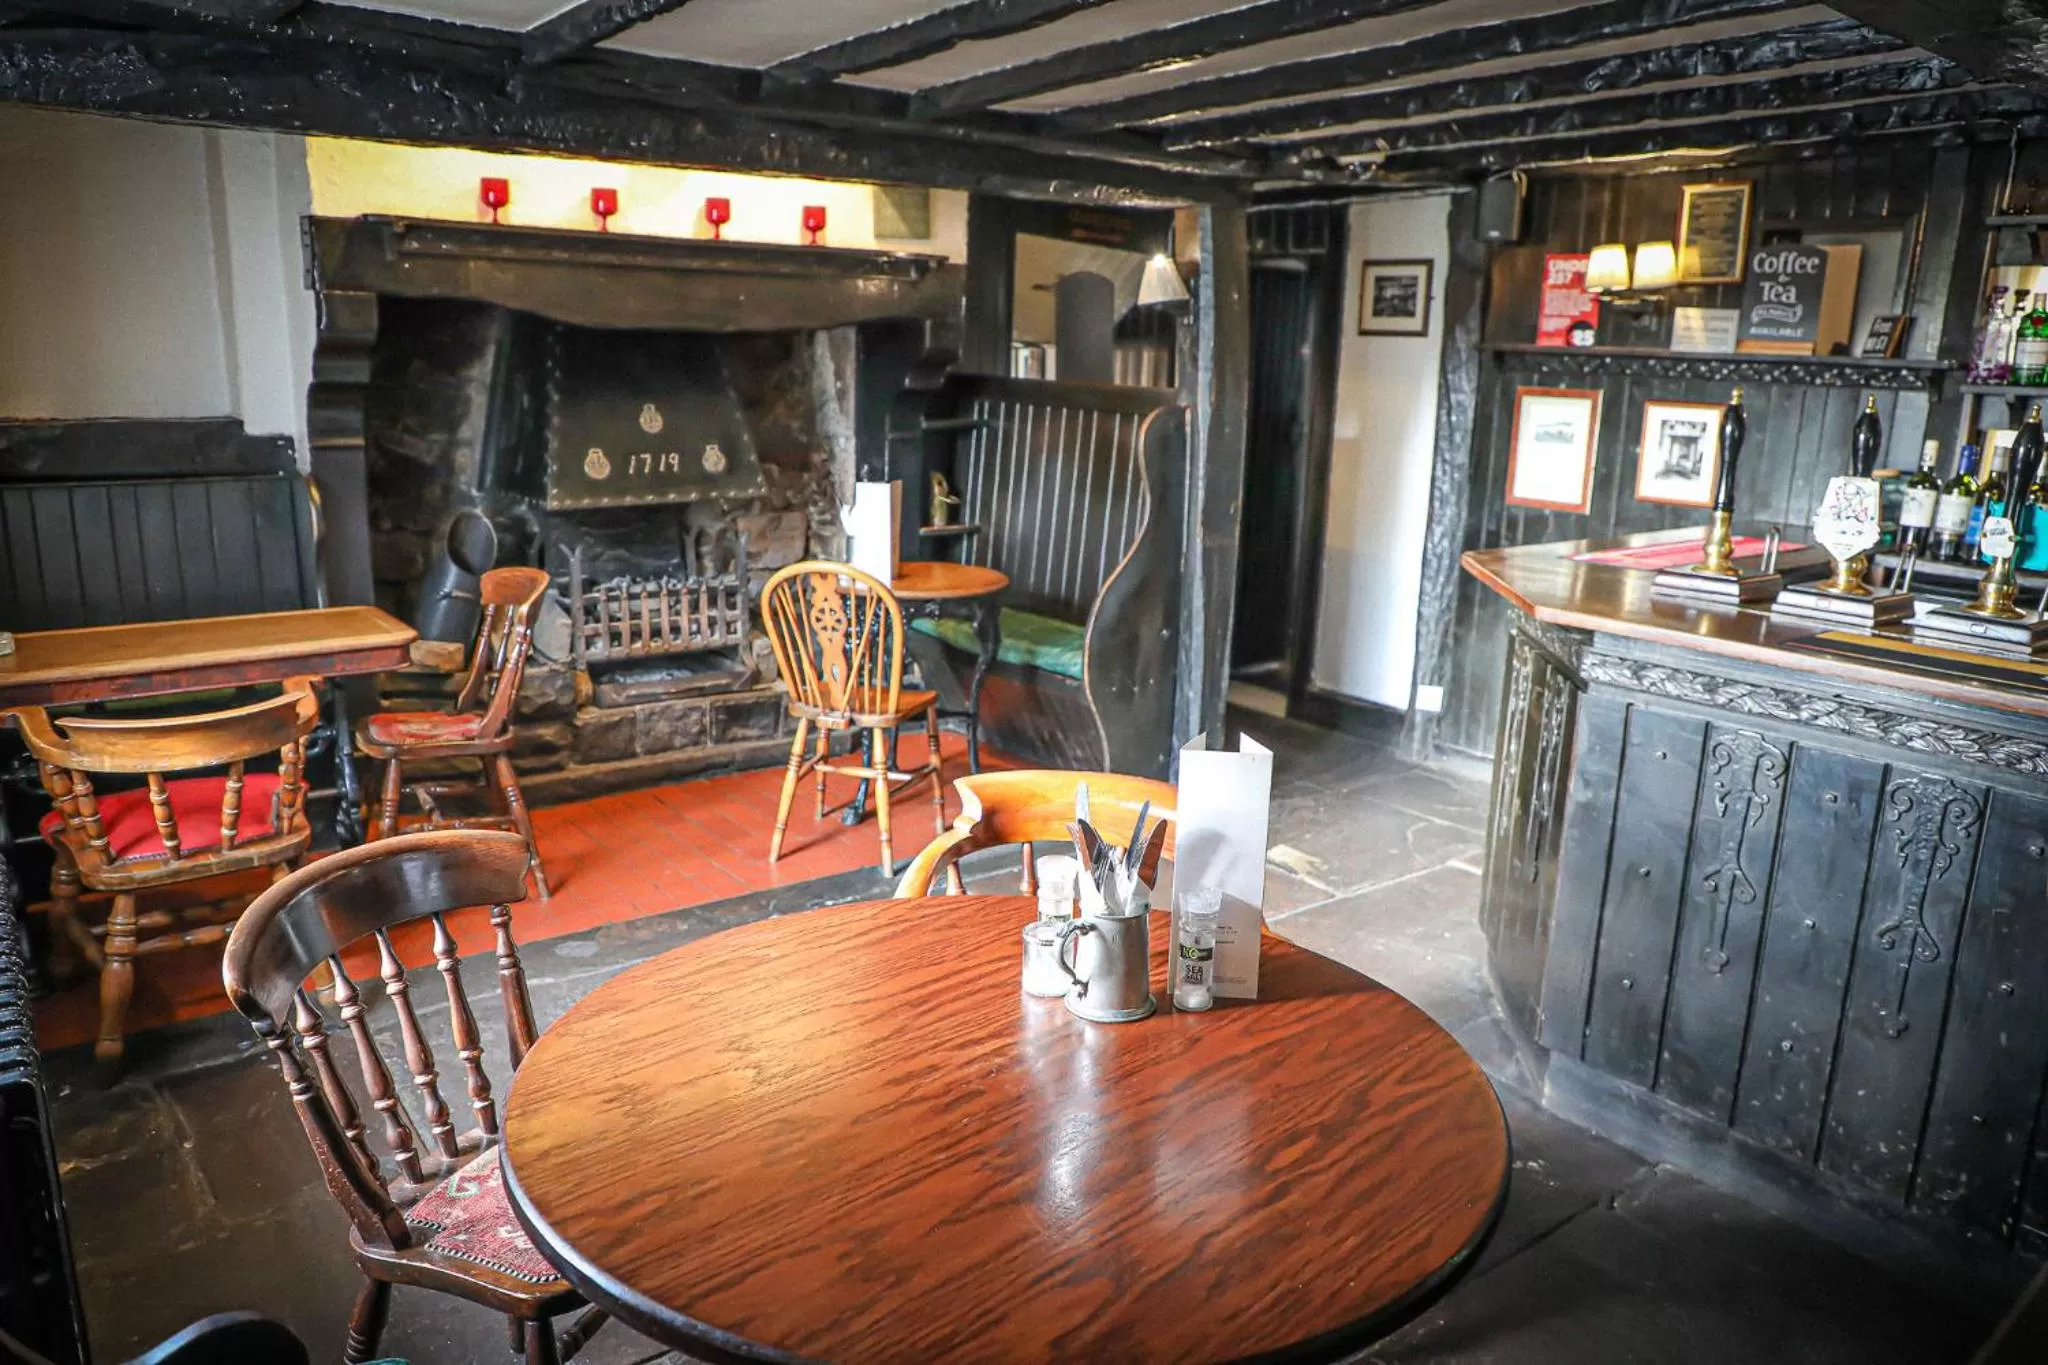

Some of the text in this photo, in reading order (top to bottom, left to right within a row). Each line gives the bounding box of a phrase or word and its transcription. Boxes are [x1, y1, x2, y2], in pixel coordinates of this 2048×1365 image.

[1753, 251, 1820, 274] Coffee
[1760, 281, 1797, 304] Tea
[1185, 964, 1204, 974] SEA
[1185, 973, 1203, 981] SALT
